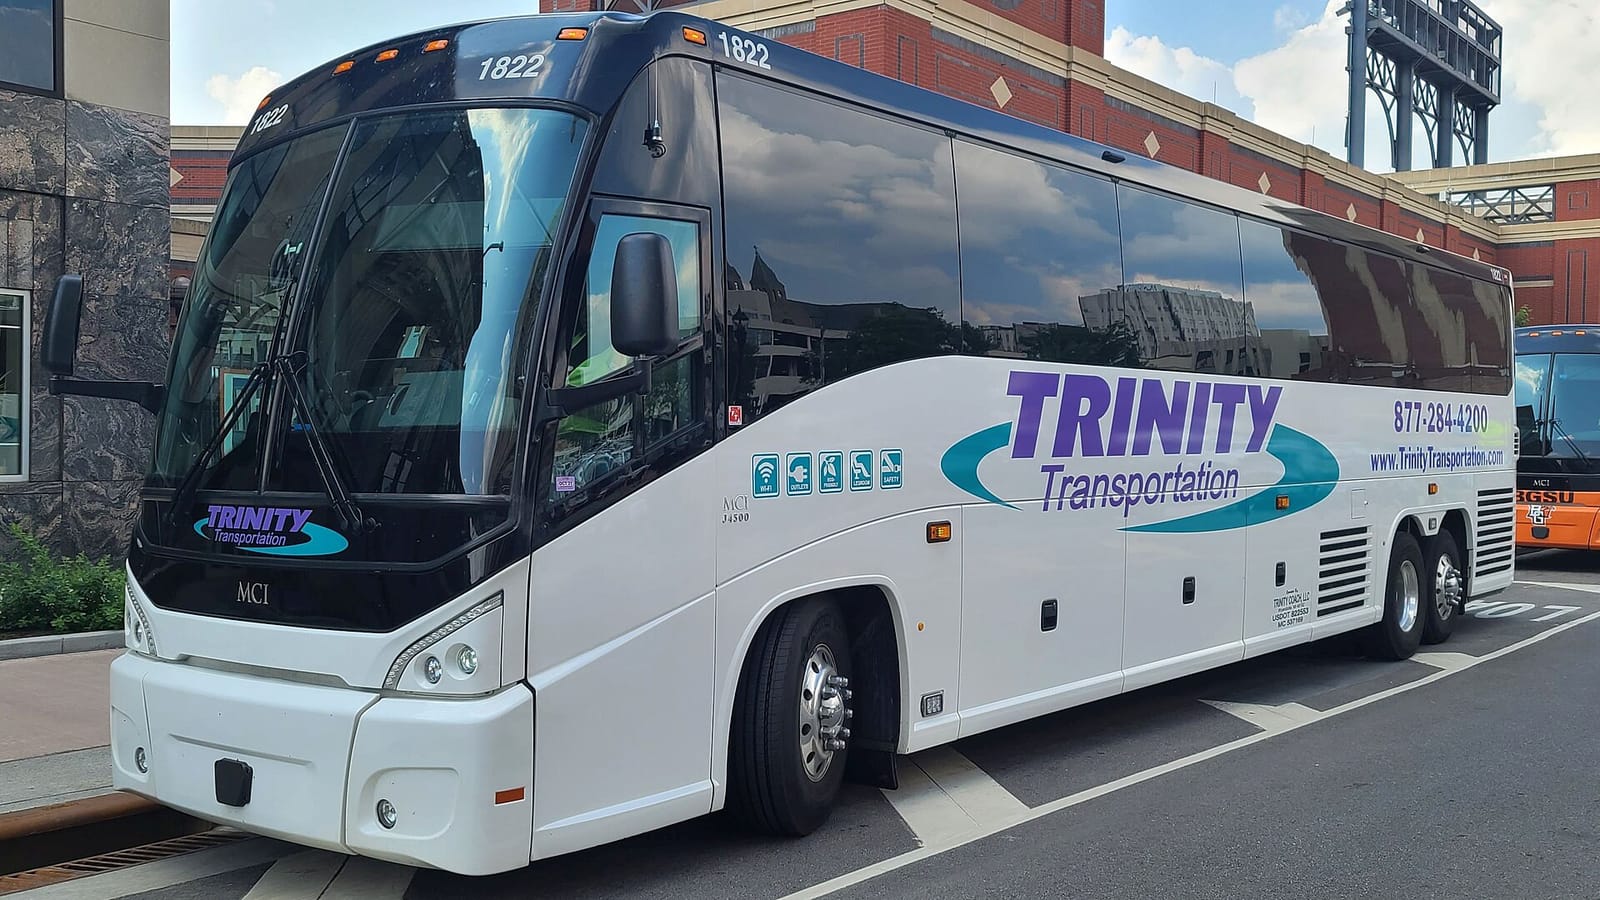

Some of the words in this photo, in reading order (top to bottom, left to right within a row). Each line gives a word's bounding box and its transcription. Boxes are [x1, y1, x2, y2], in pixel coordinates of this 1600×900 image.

[717, 32, 772, 71] 1822
[478, 54, 546, 81] 1822
[252, 103, 289, 136] 1822
[1006, 370, 1283, 459] TRINITY
[1394, 400, 1488, 433] 877-284-4200
[1370, 446, 1504, 473] www.TrinityTransportation.com
[790, 483, 809, 491] OUTLETS
[1040, 461, 1239, 518] Transportation
[723, 495, 749, 511] MCI
[207, 505, 313, 533] TRINITY
[721, 512, 749, 524] J4500
[214, 528, 287, 546] Transportation
[236, 581, 269, 605] MCI
[1272, 611, 1290, 621] USDOT
